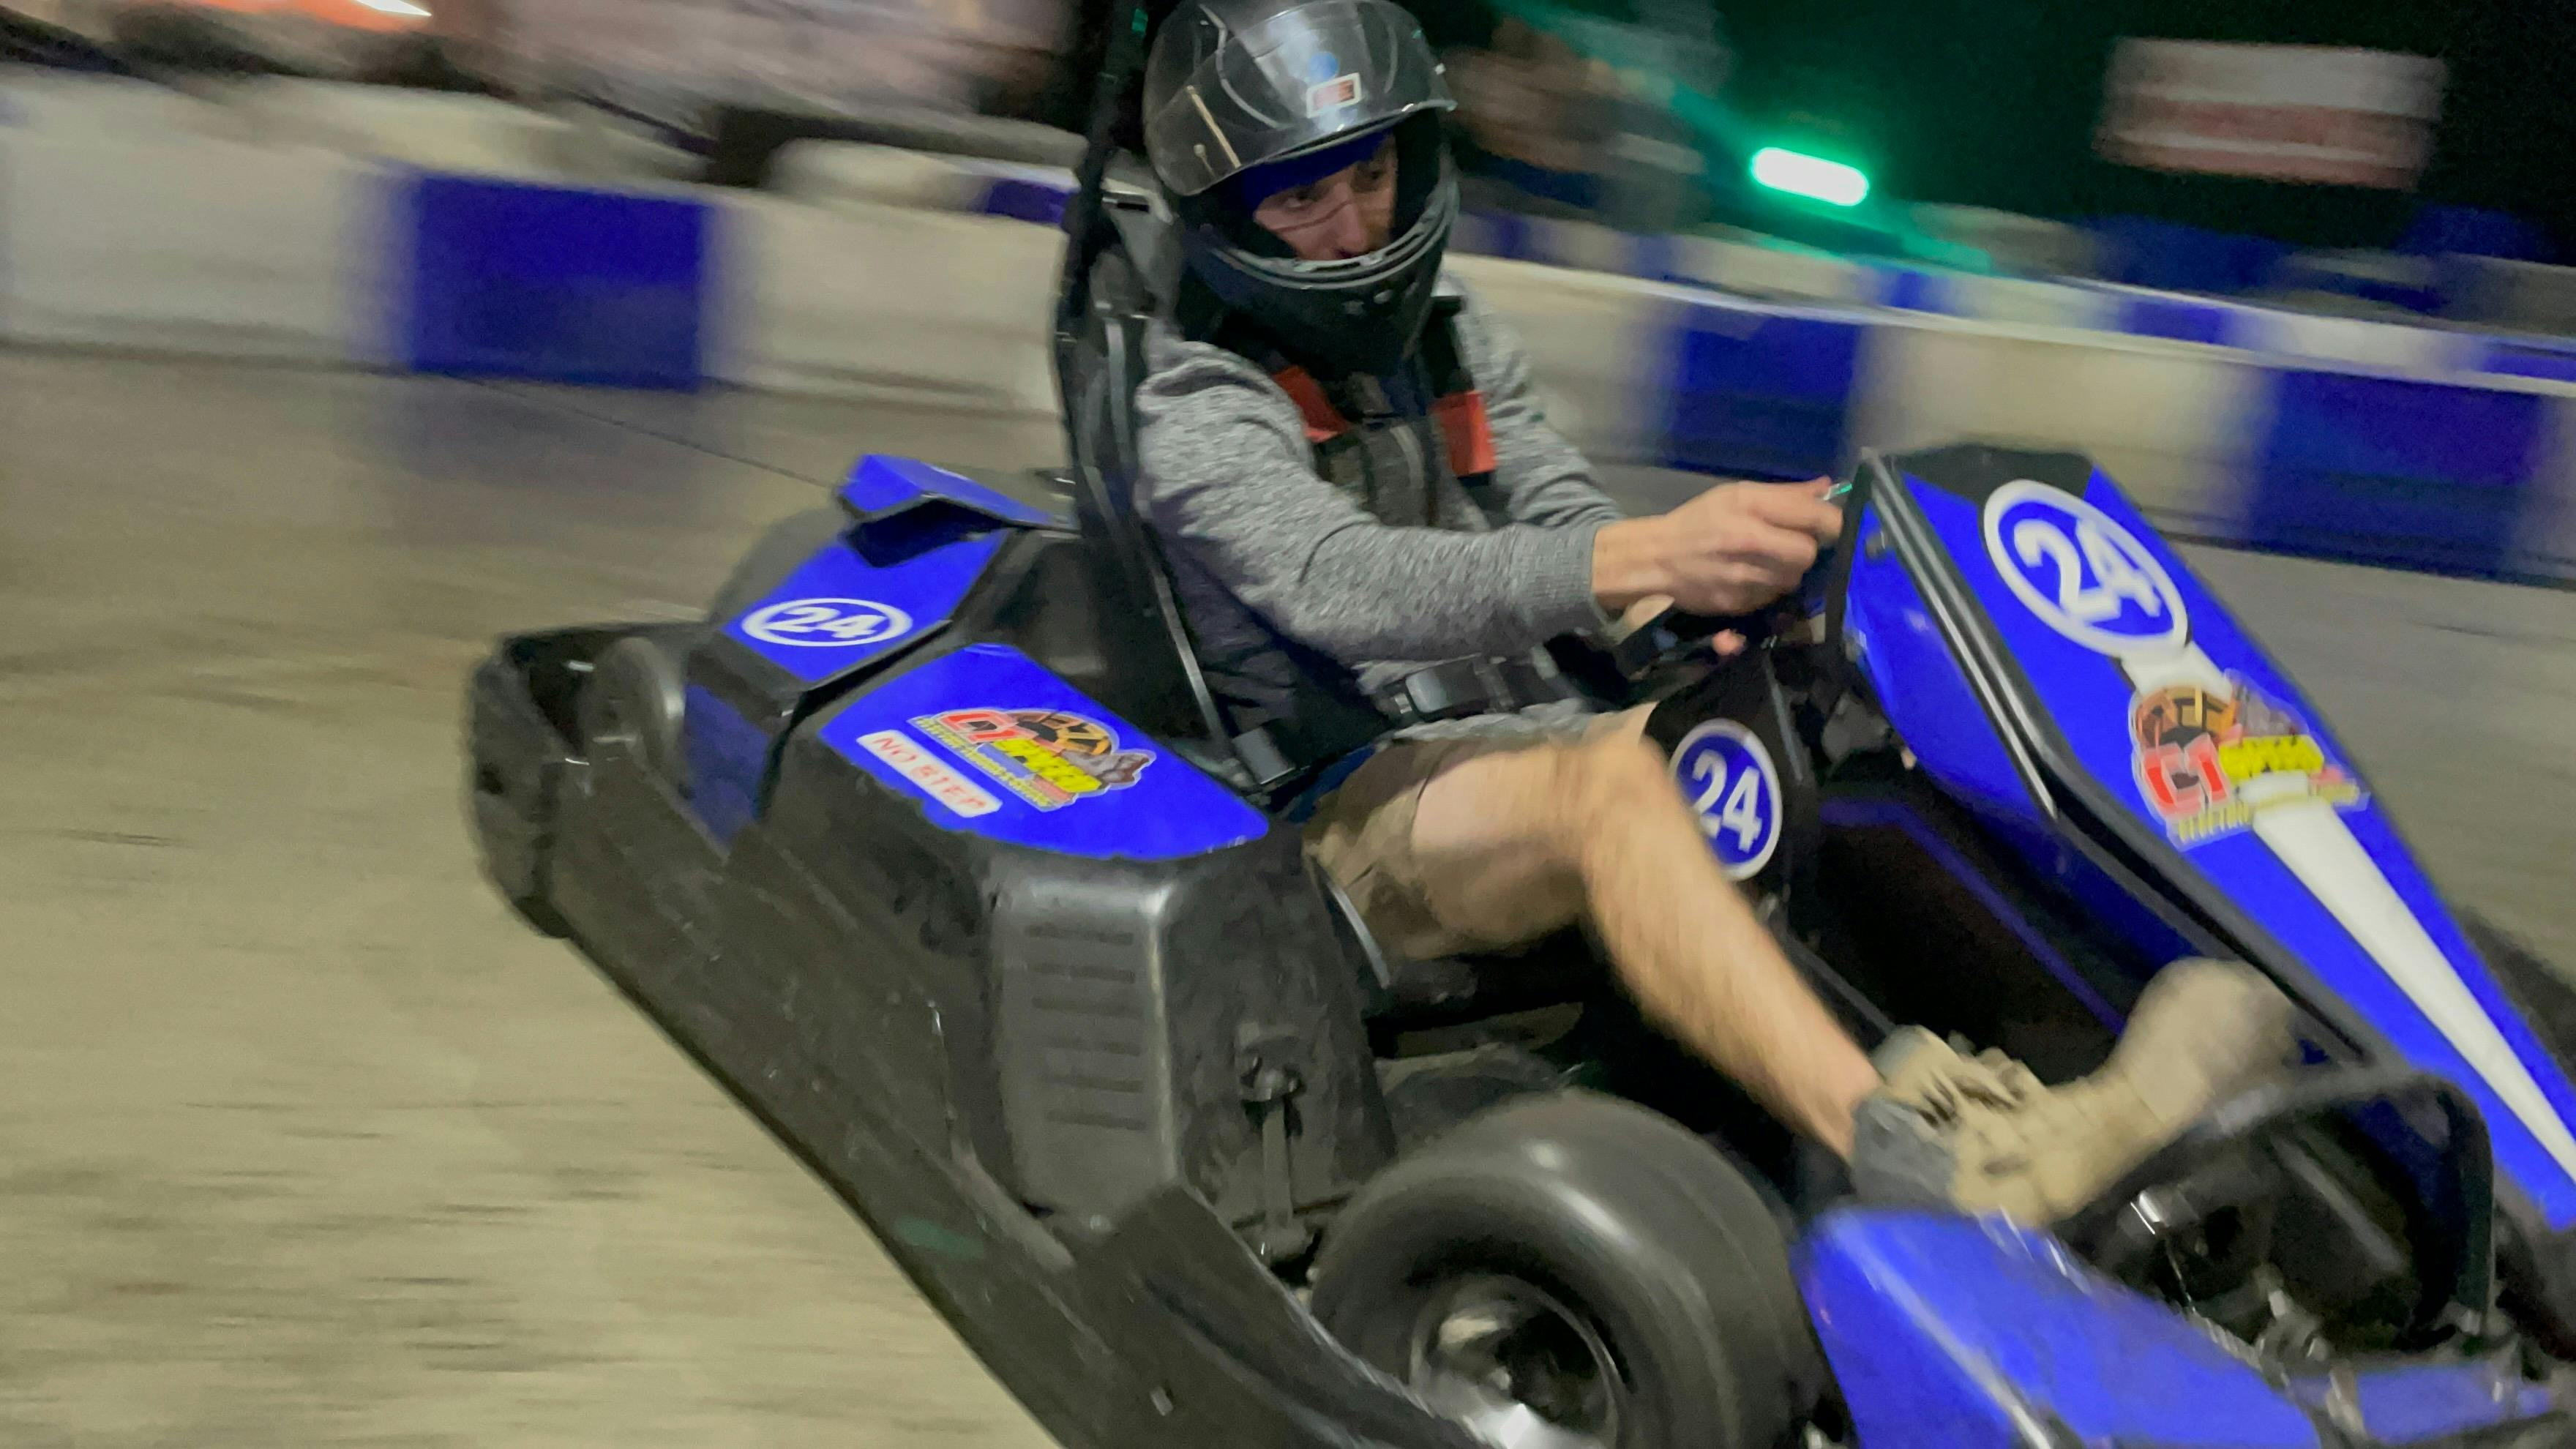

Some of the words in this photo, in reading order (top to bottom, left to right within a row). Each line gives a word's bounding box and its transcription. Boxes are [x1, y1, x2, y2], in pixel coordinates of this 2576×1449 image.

[2013, 518, 2161, 620] 24
[764, 606, 887, 638] 24
[872, 737, 916, 764] NO
[1690, 749, 1763, 854] 24
